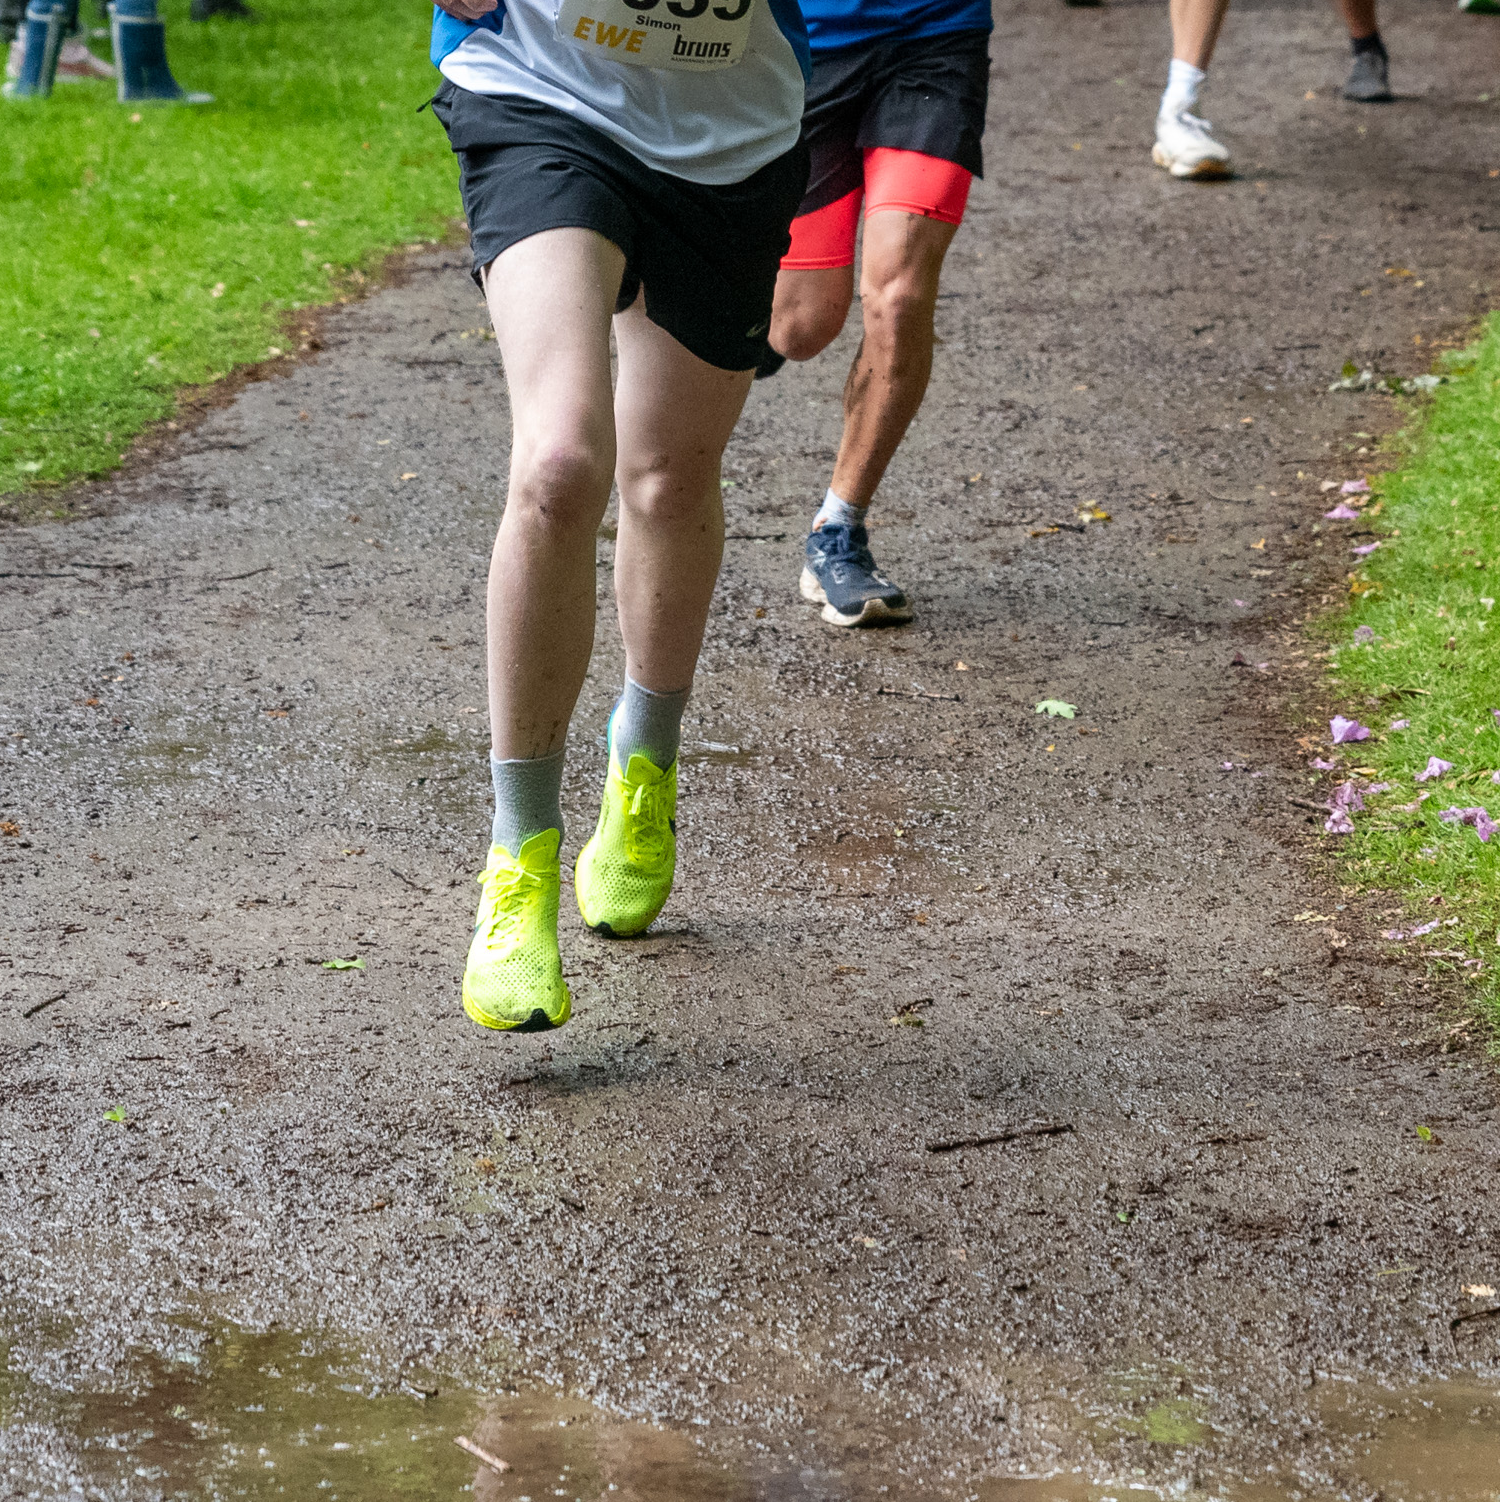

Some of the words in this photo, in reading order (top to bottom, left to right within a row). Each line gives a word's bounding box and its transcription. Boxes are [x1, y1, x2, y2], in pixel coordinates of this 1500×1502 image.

[573, 16, 648, 54] EWE
[635, 14, 681, 32] Simon
[673, 34, 732, 58] bruns
